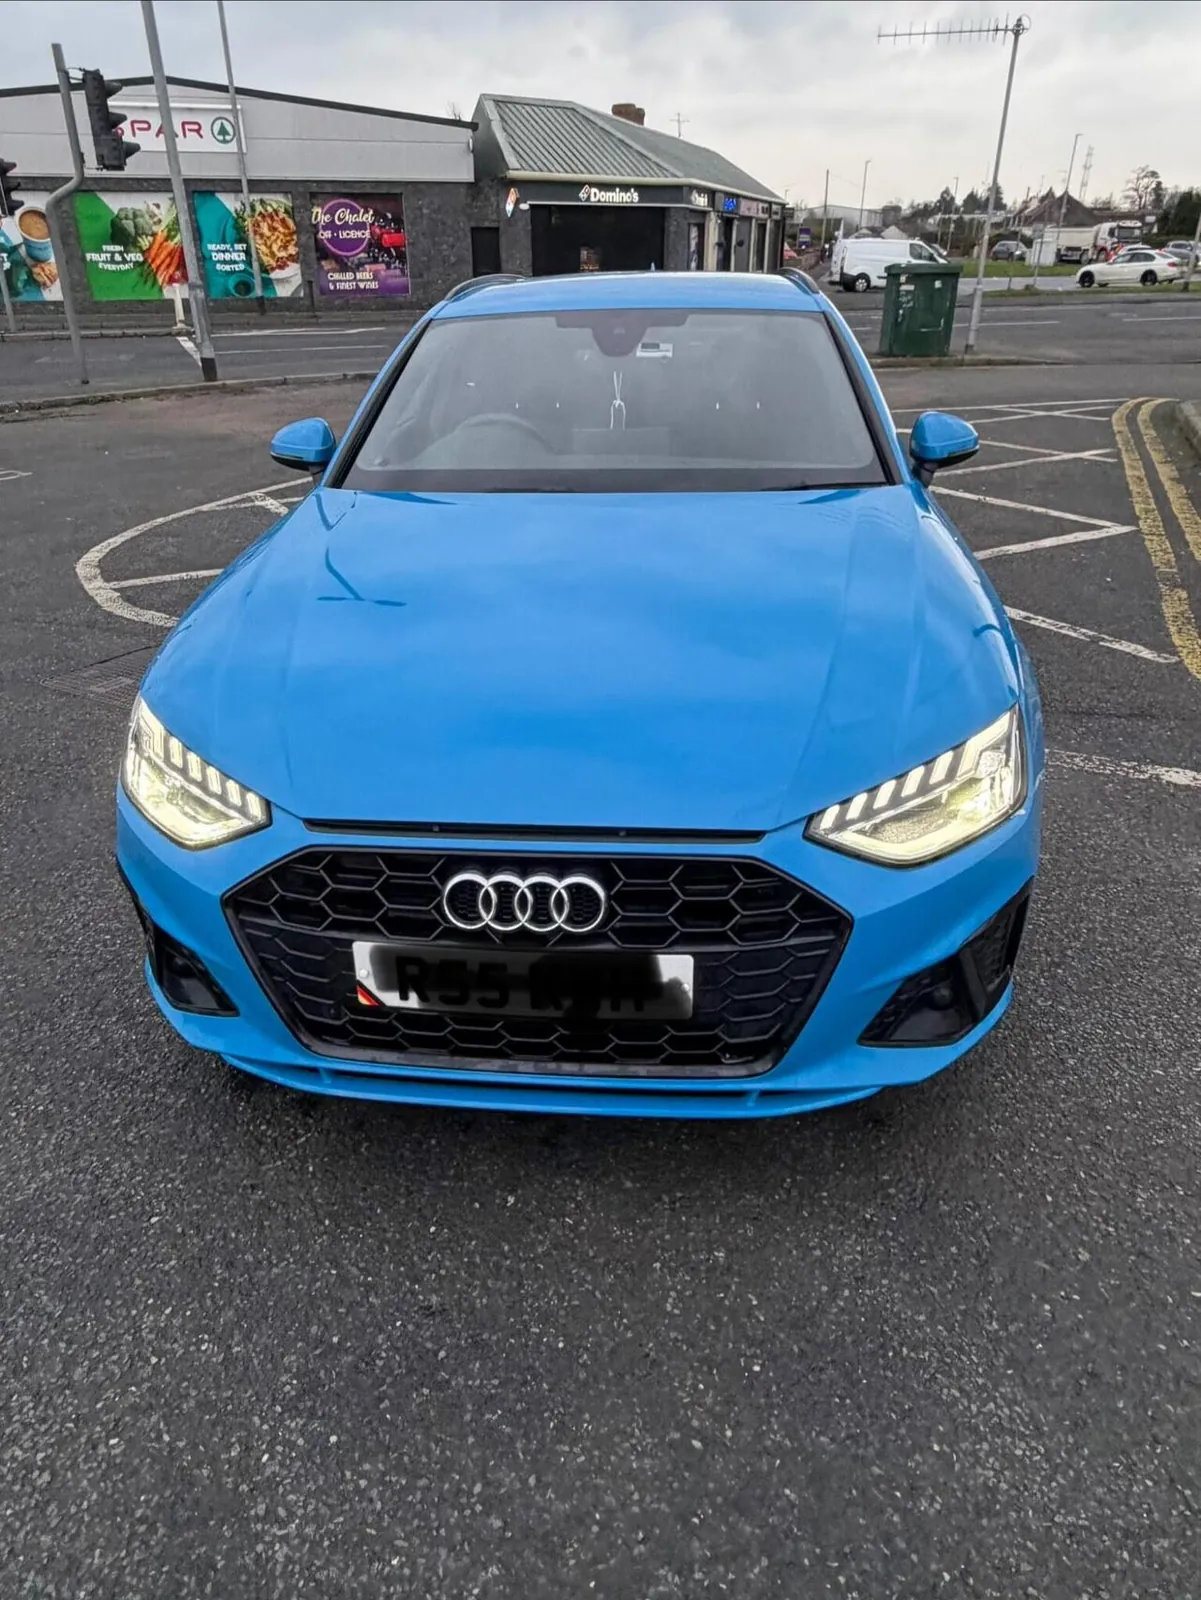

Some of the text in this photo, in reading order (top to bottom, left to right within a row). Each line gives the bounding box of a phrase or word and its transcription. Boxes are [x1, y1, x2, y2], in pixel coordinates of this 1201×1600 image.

[590, 187, 639, 203] Domino's
[311, 206, 375, 225] The Chalet
[319, 229, 371, 239] OFF LICENCE
[102, 244, 124, 252] FRESH
[207, 243, 233, 252] READY,
[85, 253, 144, 262] FRUIT & VEG
[211, 252, 246, 261] DINNER
[98, 262, 134, 272] EVERYDAY
[215, 263, 245, 271] SORTED
[327, 271, 373, 280] CHILLED BEERS
[336, 281, 356, 290] FINEST
[357, 281, 379, 290] WINES
